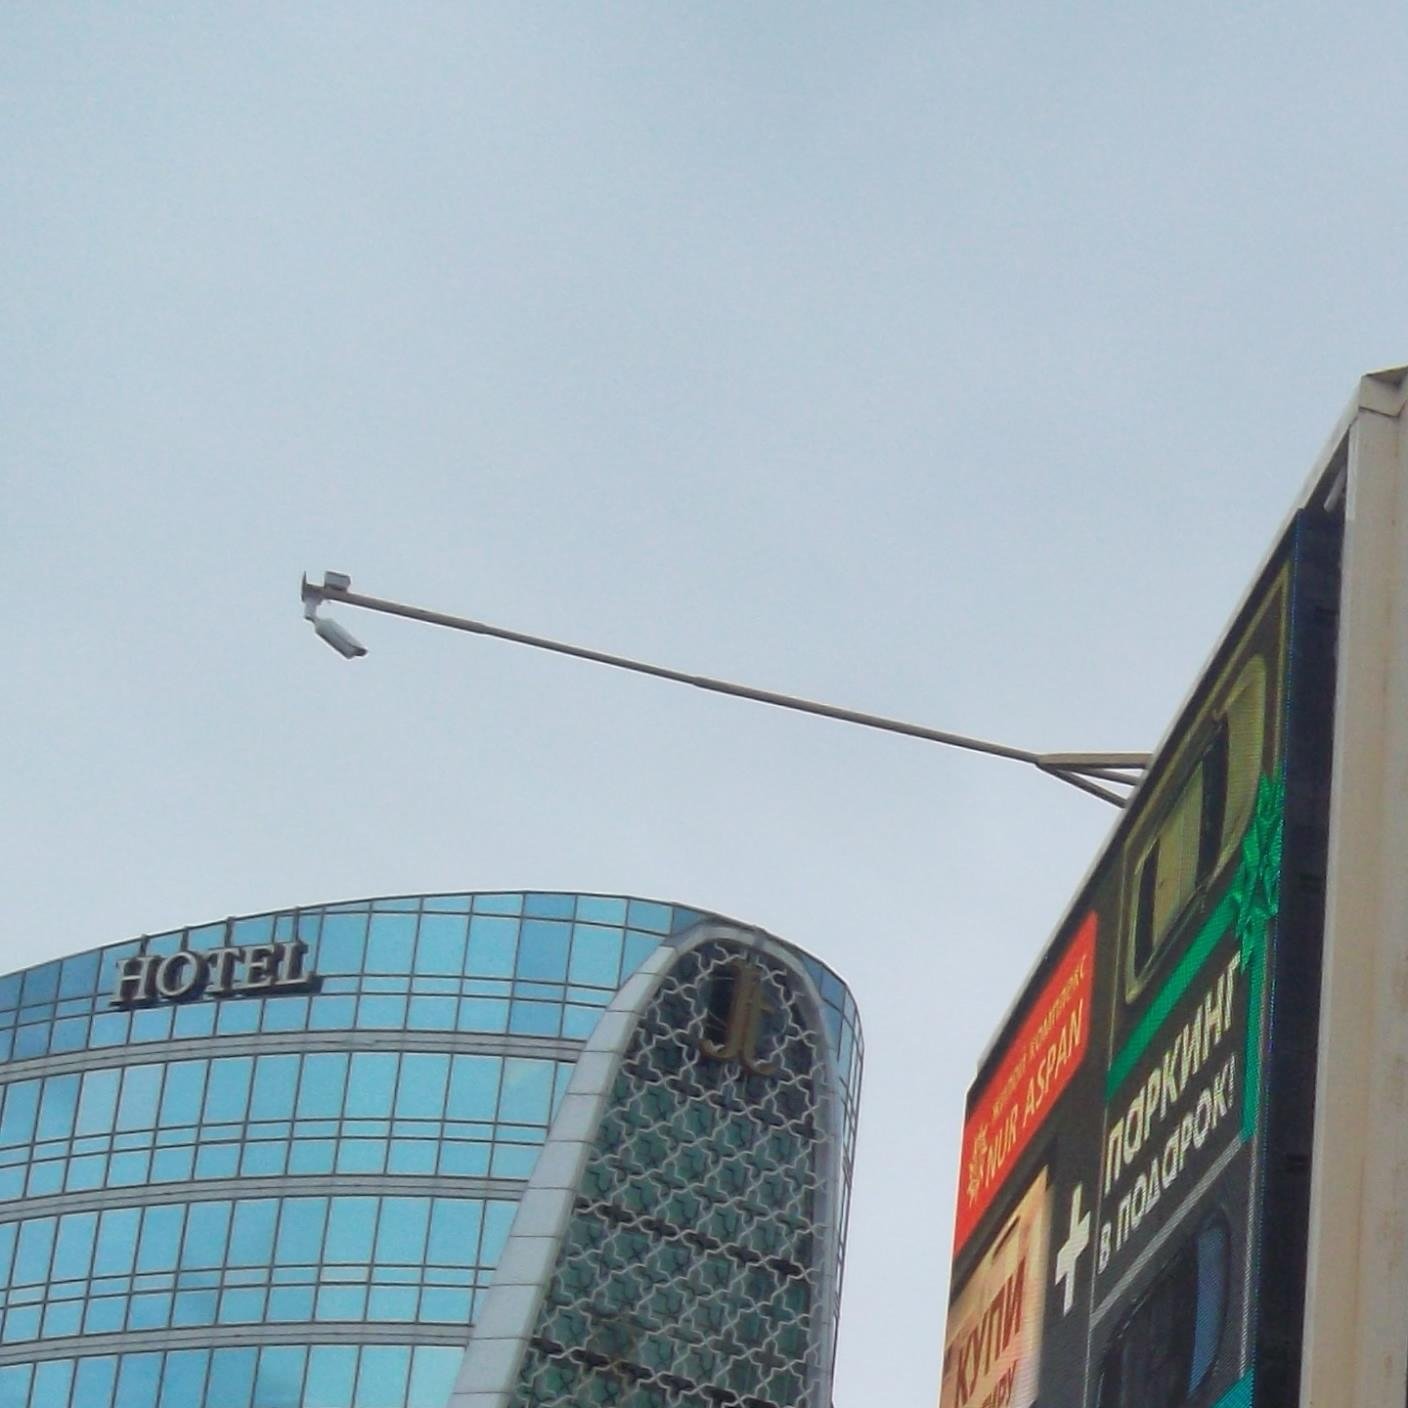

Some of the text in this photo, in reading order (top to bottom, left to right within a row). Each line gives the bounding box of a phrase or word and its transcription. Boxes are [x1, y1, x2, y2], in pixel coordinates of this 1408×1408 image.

[114, 942, 313, 1003] HOTEL
[985, 1103, 1018, 1188] NUR
[1022, 998, 1083, 1128] ASPAN
